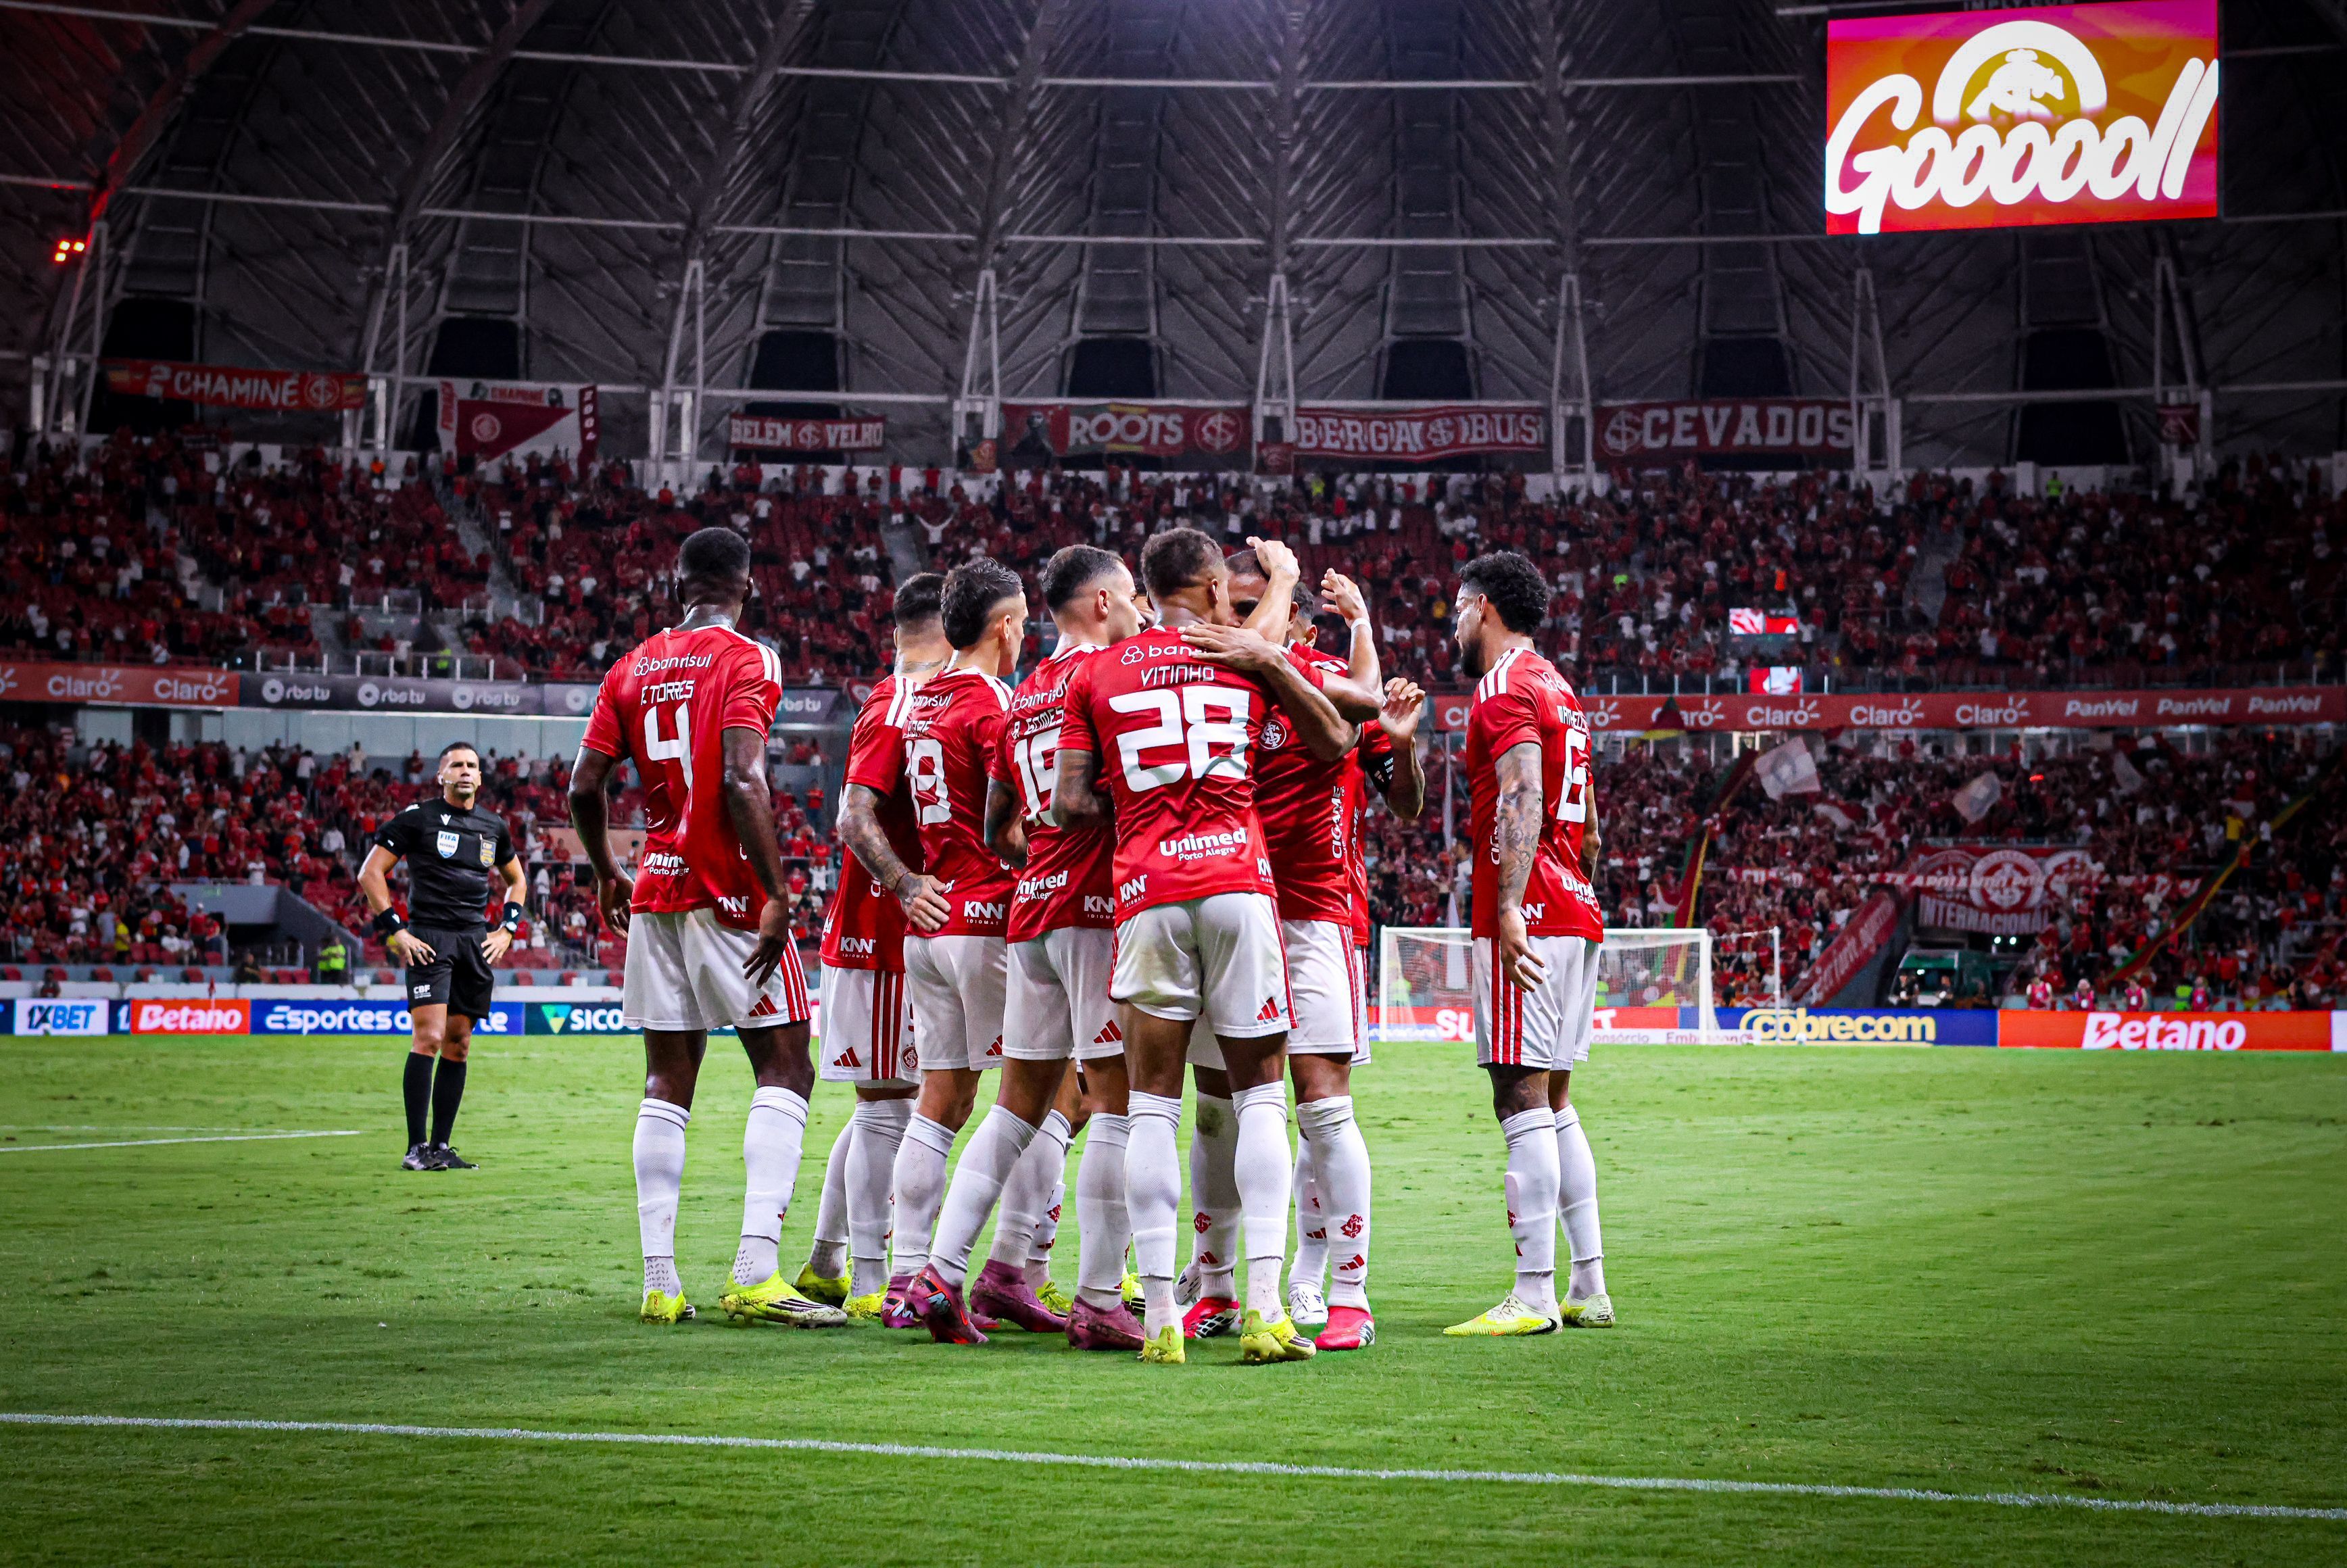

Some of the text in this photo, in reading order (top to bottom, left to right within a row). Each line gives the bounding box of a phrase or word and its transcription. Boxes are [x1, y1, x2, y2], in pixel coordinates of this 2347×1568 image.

[1069, 412, 1185, 447] ROOTS
[1642, 405, 1854, 449] CEVADOS
[649, 653, 713, 672] banrisul
[47, 673, 220, 702] Claro Claro
[1140, 664, 1216, 687] VITINHO
[1746, 703, 1812, 726] Claro
[1849, 702, 1916, 726] Claro
[1955, 701, 2021, 725] Claro
[2064, 698, 2139, 718] PanVel
[2156, 697, 2231, 716] PanVel
[2248, 695, 2321, 714] PanVel
[644, 702, 693, 790] 4
[1109, 685, 1251, 793] 28
[1555, 728, 1589, 823] 6
[439, 833, 457, 842] FIFA
[1159, 827, 1248, 857] Unimed
[644, 852, 685, 868] Unim
[1178, 847, 1236, 862] Porto Alegre
[649, 866, 669, 876] Porto
[1119, 875, 1147, 903] KNN
[963, 900, 1003, 919] KNN
[840, 936, 873, 954] KNN
[413, 984, 431, 994] CBF
[28, 1004, 96, 1029] 1XBET
[138, 1004, 243, 1031] Betano
[265, 1005, 391, 1035] Esportes
[569, 1007, 626, 1031] SICO
[1756, 1008, 1937, 1041] cobrecom
[2081, 1012, 2246, 1051] Betano
